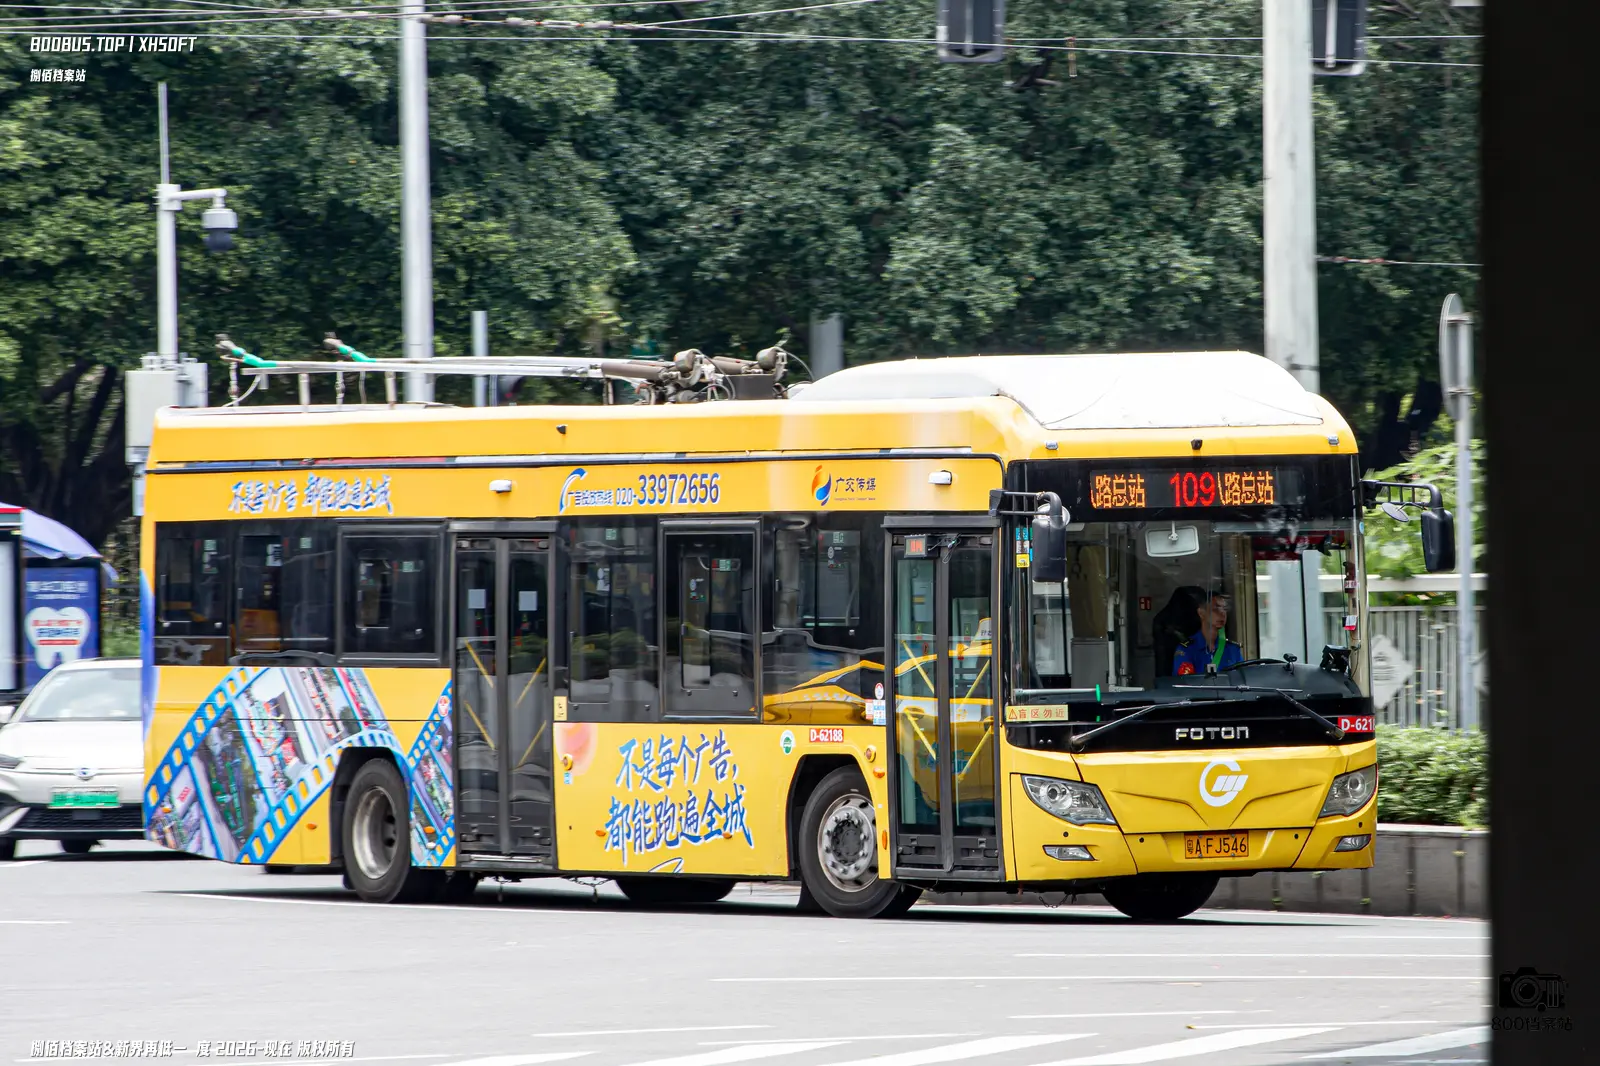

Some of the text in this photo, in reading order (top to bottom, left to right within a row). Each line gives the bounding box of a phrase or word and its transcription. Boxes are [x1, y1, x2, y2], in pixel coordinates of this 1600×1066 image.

[616, 472, 720, 506] 020-33972656
[834, 477, 877, 493] 广交传媒
[1090, 471, 1274, 509] 路总站 109 路总站
[1018, 708, 1065, 719] 盲区勿近
[810, 729, 843, 742] D-62188
[1175, 726, 1249, 741] FOTON
[604, 782, 754, 866] 都能跑遍全城
